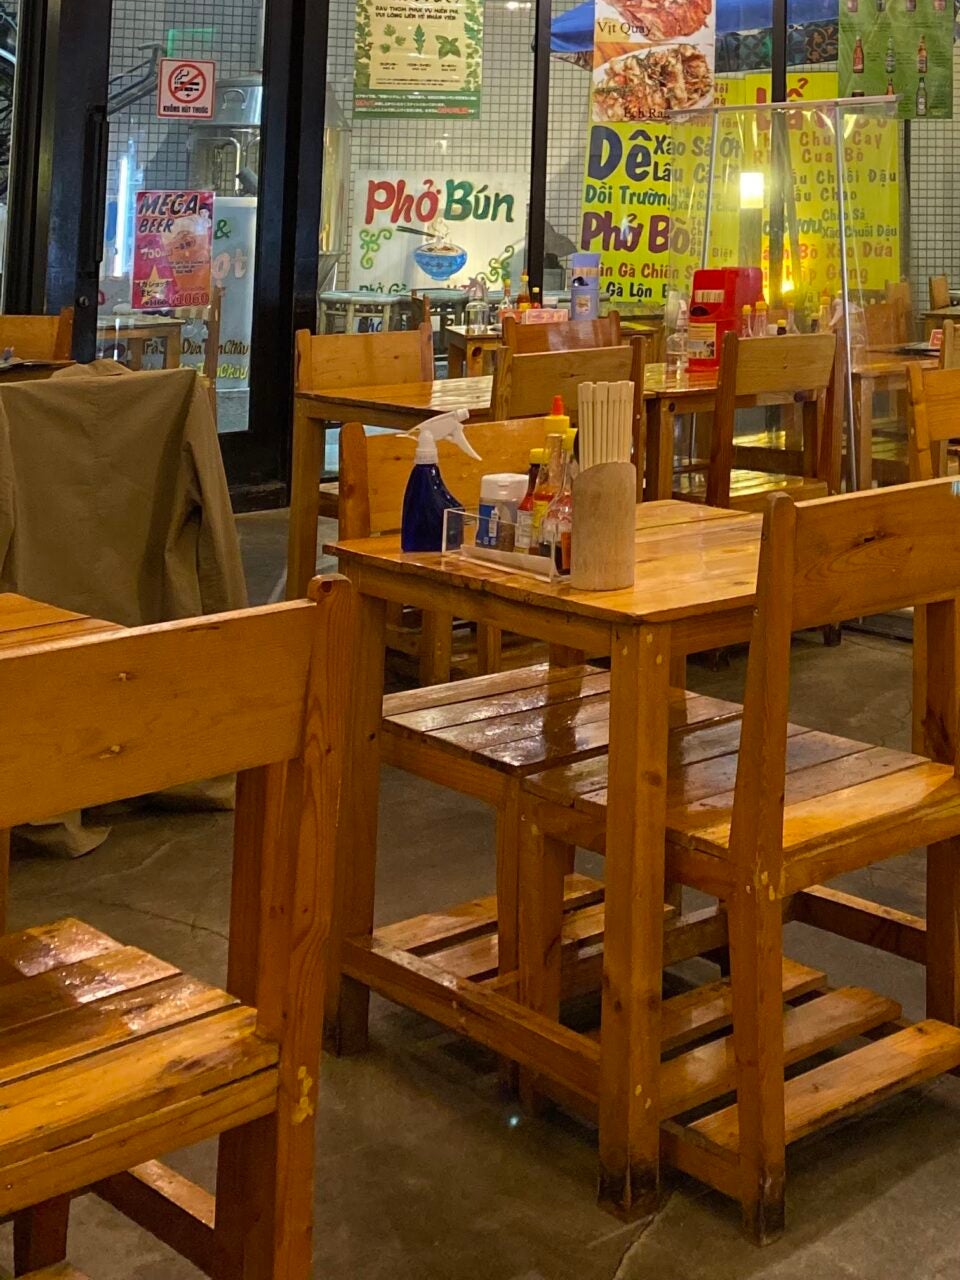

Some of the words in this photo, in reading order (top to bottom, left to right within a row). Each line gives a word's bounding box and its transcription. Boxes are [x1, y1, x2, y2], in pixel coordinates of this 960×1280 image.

[596, 21, 617, 36] Vịt
[619, 21, 653, 37] Quay
[800, 131, 836, 148] Chu
[587, 125, 653, 182] Dê
[138, 193, 200, 218] MEGA
[365, 179, 442, 225] Phở
[443, 179, 515, 223] Bún
[585, 181, 613, 204] Dồi
[619, 185, 678, 212] Trường
[138, 218, 175, 234] BEER
[580, 210, 644, 253] Phở
[648, 214, 690, 255] Bò
[618, 261, 636, 279] Gà
[606, 281, 624, 298] Gà
